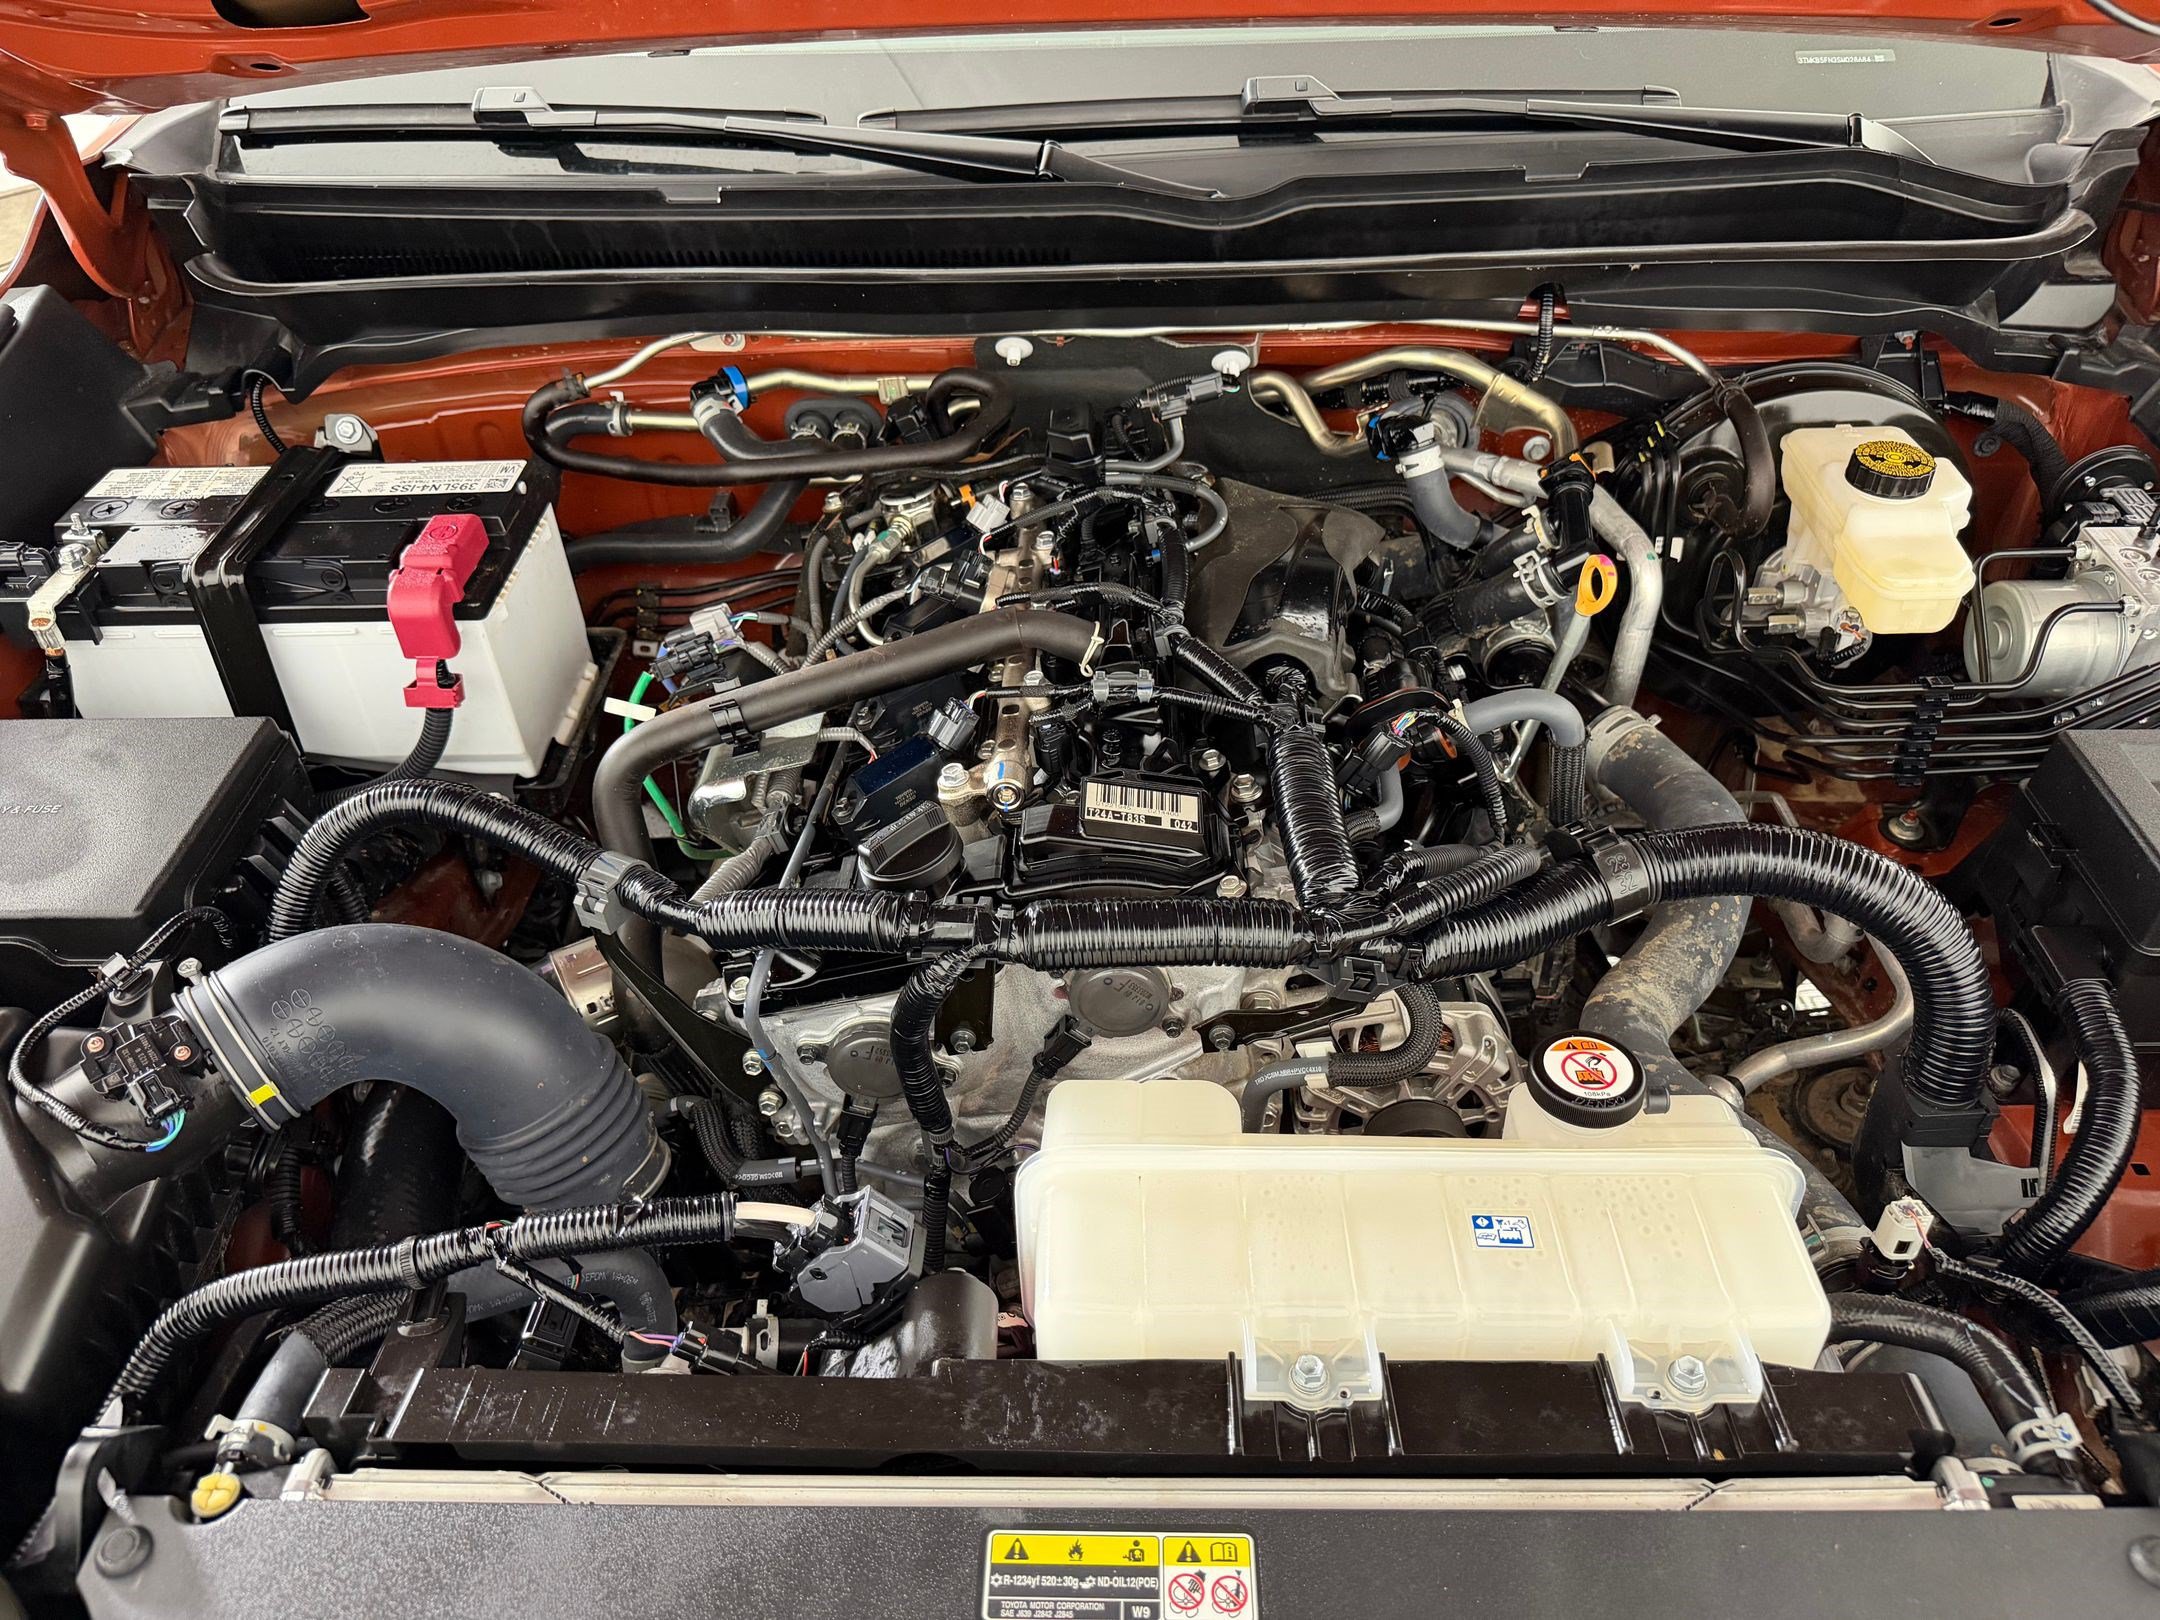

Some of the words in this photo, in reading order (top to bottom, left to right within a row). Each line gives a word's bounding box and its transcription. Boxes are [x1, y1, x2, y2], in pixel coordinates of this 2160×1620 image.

[389, 482, 480, 494] 395LN4-ISS
[23, 804, 63, 814] FUSE
[1088, 807, 1146, 824] T24A-T83S
[1174, 821, 1193, 831] 042
[1605, 853, 1632, 877] 28
[1614, 871, 1639, 895] 32
[1571, 1095, 1627, 1109] DENSO
[1003, 1574, 1040, 1589] R-1234yf
[1041, 1575, 1079, 1590] 520±30g
[1097, 1575, 1159, 1590] ND-OIL12(POE)
[1000, 1601, 1028, 1609] TOYOTA
[1029, 1601, 1055, 1610] MOTOR
[1056, 1602, 1105, 1611] CORPORATION
[1000, 1609, 1015, 1617] SAE
[1131, 1605, 1151, 1619] W9
